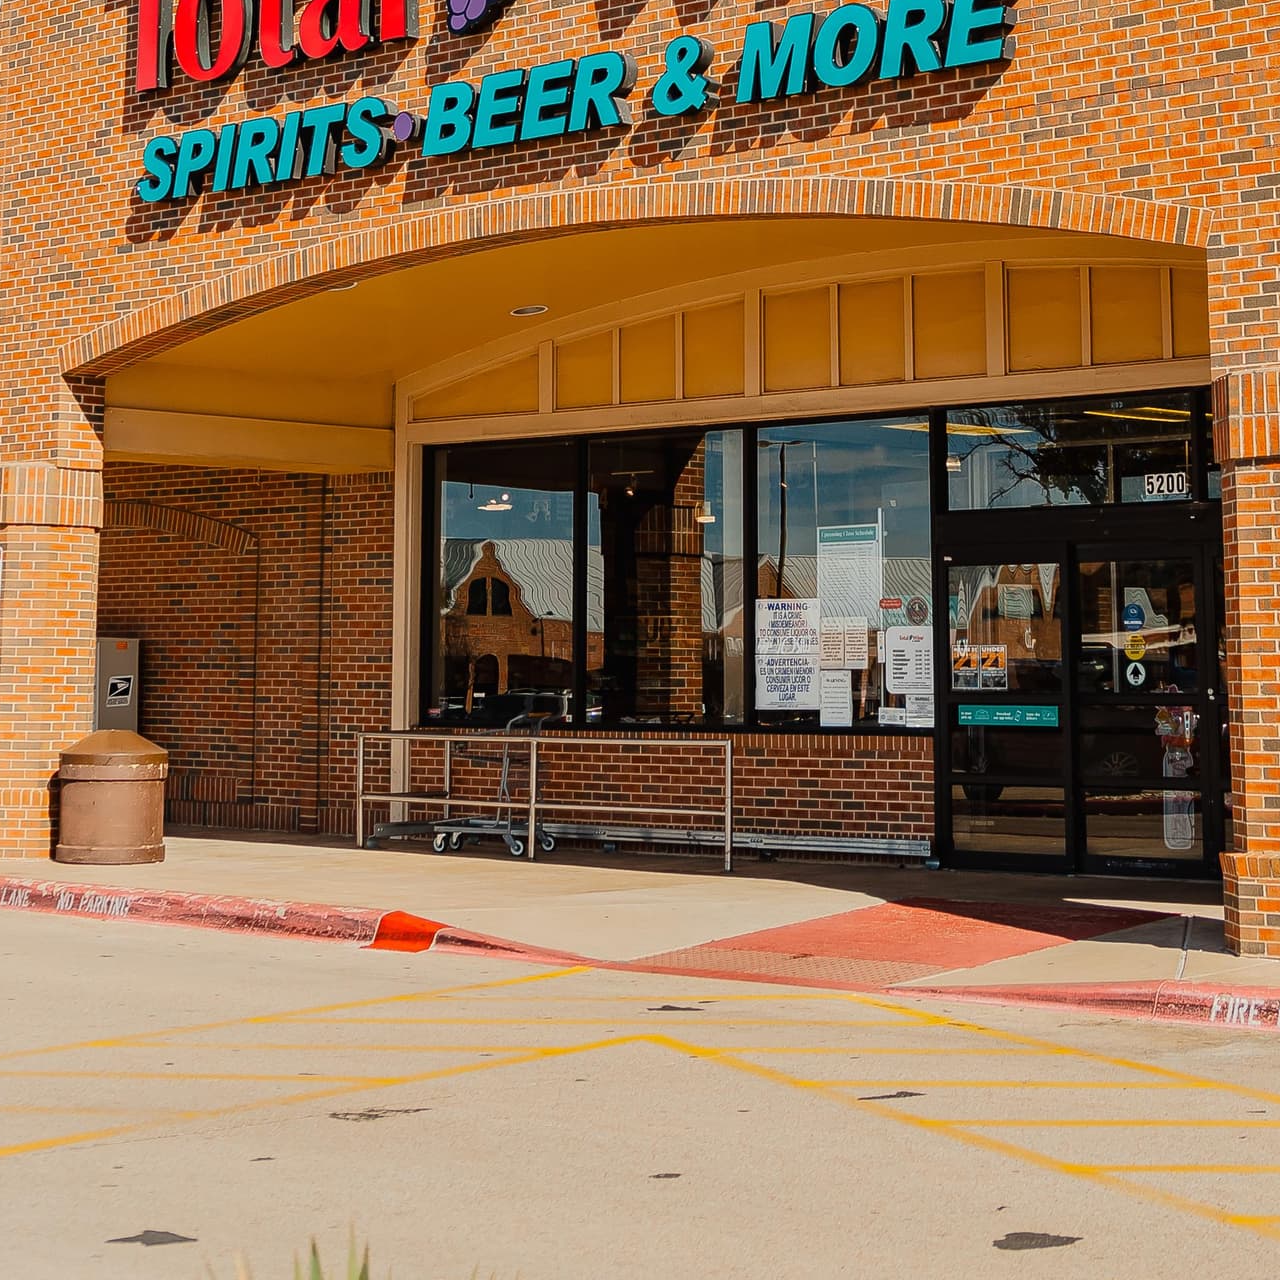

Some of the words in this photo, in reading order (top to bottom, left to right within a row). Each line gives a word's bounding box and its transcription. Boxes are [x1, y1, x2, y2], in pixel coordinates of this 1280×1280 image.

[137, 97, 398, 201] SPIRITS
[421, 51, 637, 156] BEER
[652, 35, 714, 115] &
[1147, 474, 1184, 494] 5200
[981, 652, 1005, 670] 21
[56, 891, 75, 911] NO
[79, 894, 132, 917] PARKING
[1209, 995, 1265, 1026] FIRE
